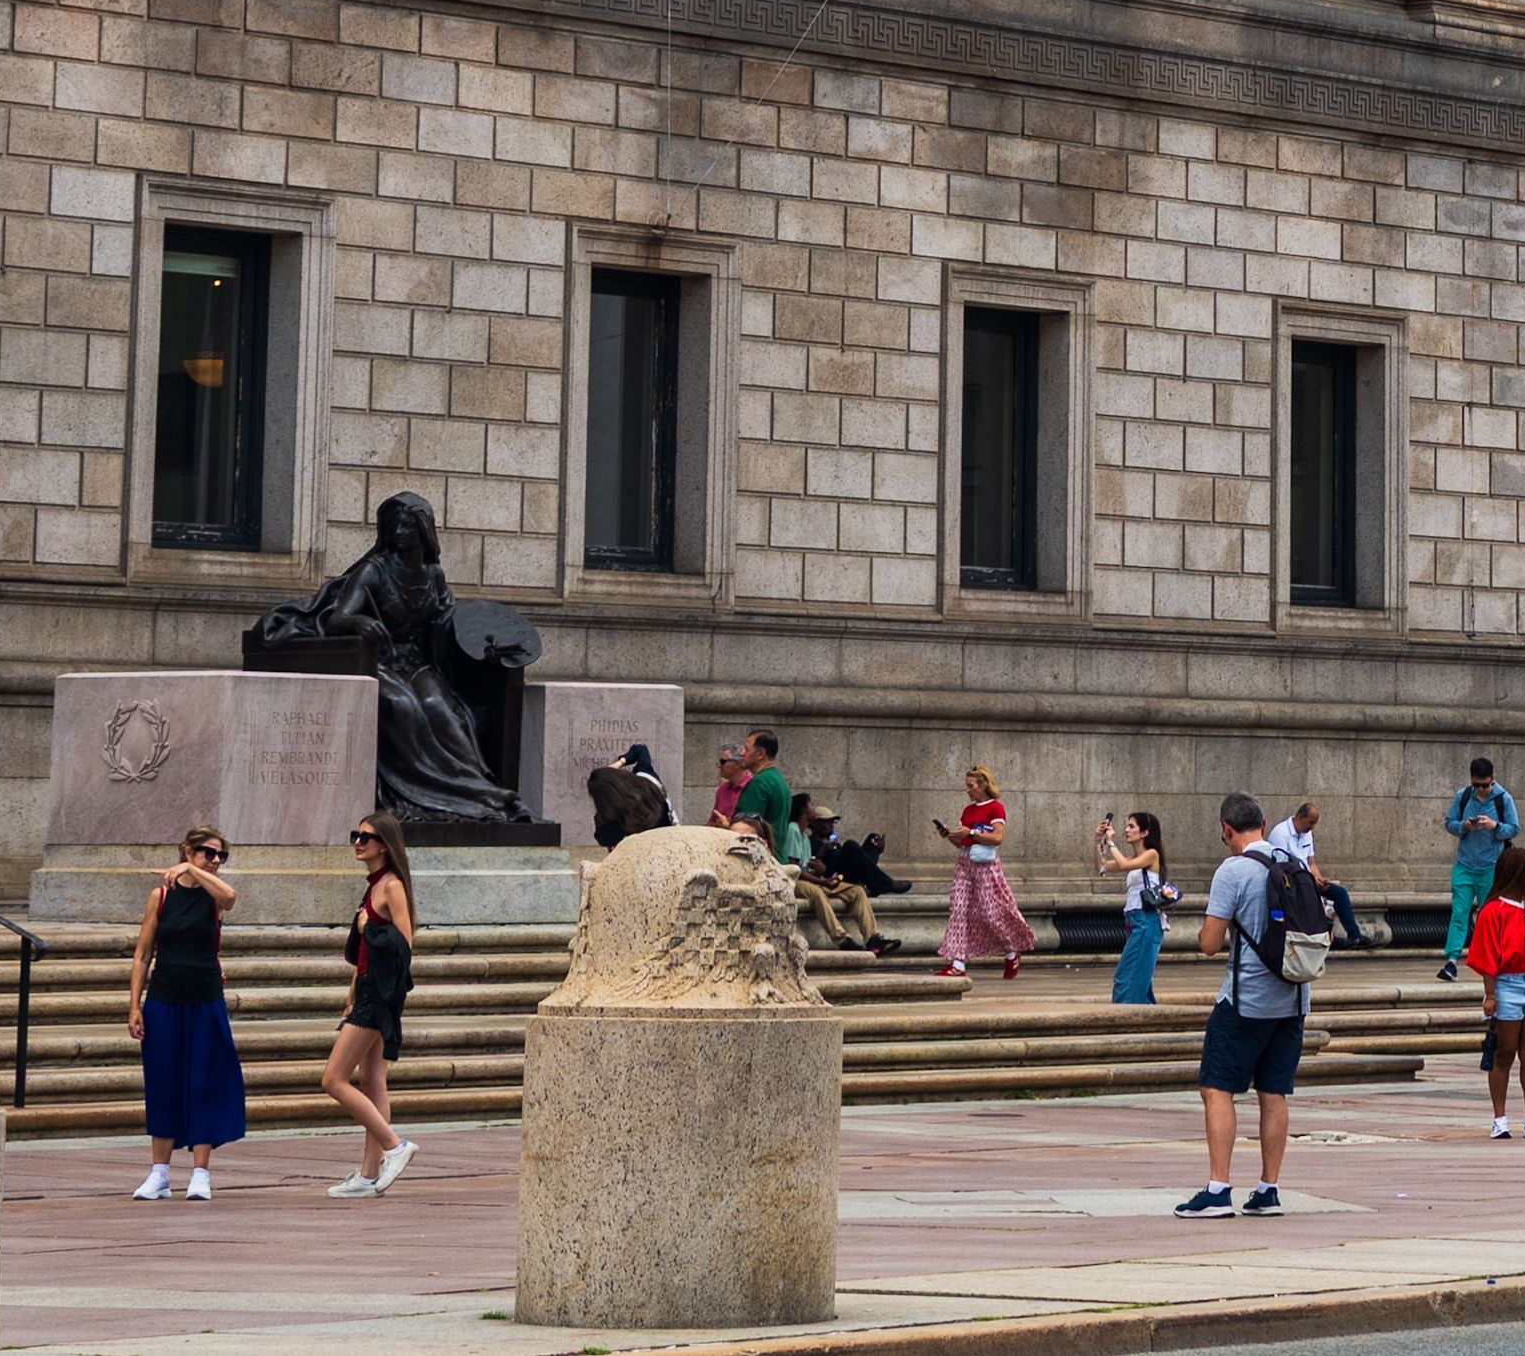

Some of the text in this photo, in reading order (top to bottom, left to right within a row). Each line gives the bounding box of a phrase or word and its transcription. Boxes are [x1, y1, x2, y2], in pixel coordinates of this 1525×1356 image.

[272, 711, 331, 727] RAPHAEL
[590, 720, 640, 734] PHIDIAS
[280, 731, 325, 745] TITIAN
[261, 751, 340, 766] REMBRANDT
[259, 770, 341, 786] VELASQUEZ
